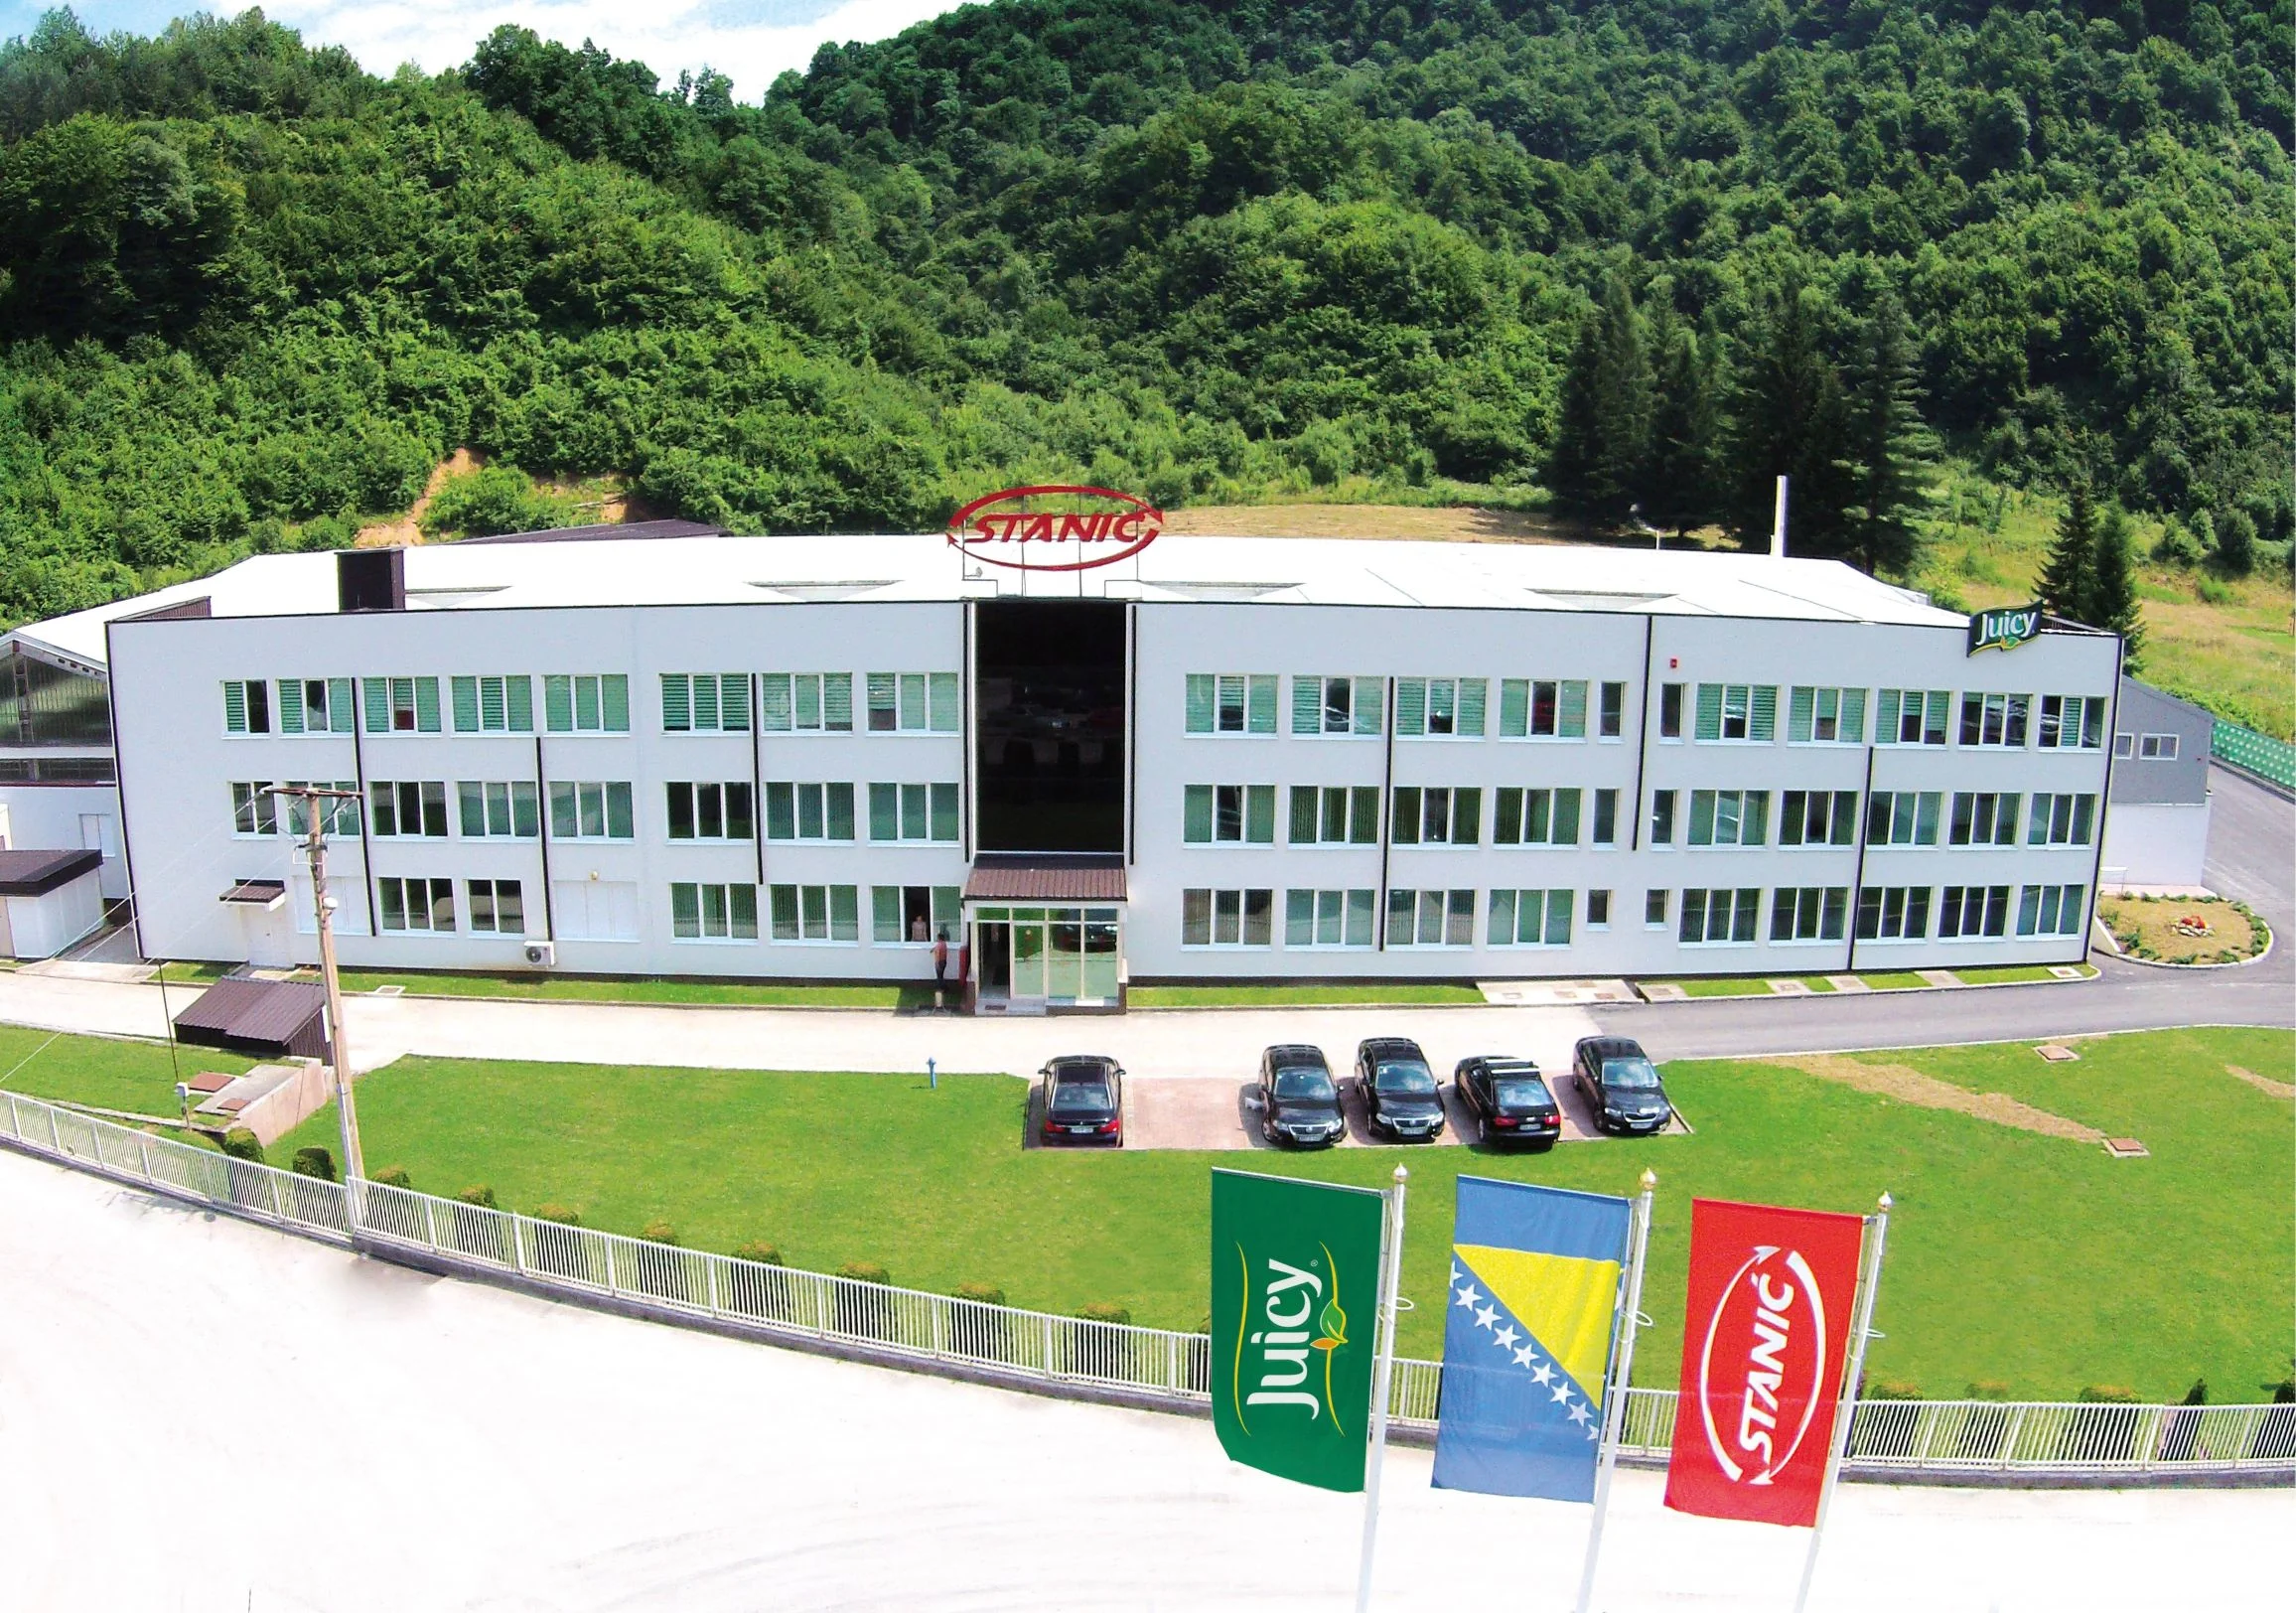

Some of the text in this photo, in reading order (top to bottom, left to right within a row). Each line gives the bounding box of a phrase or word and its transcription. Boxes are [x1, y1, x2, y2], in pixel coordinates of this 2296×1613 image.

[1975, 610, 2037, 646] Juicy
[1246, 1257, 1323, 1420] Juicy
[1739, 1271, 1794, 1465] STANIĆ
